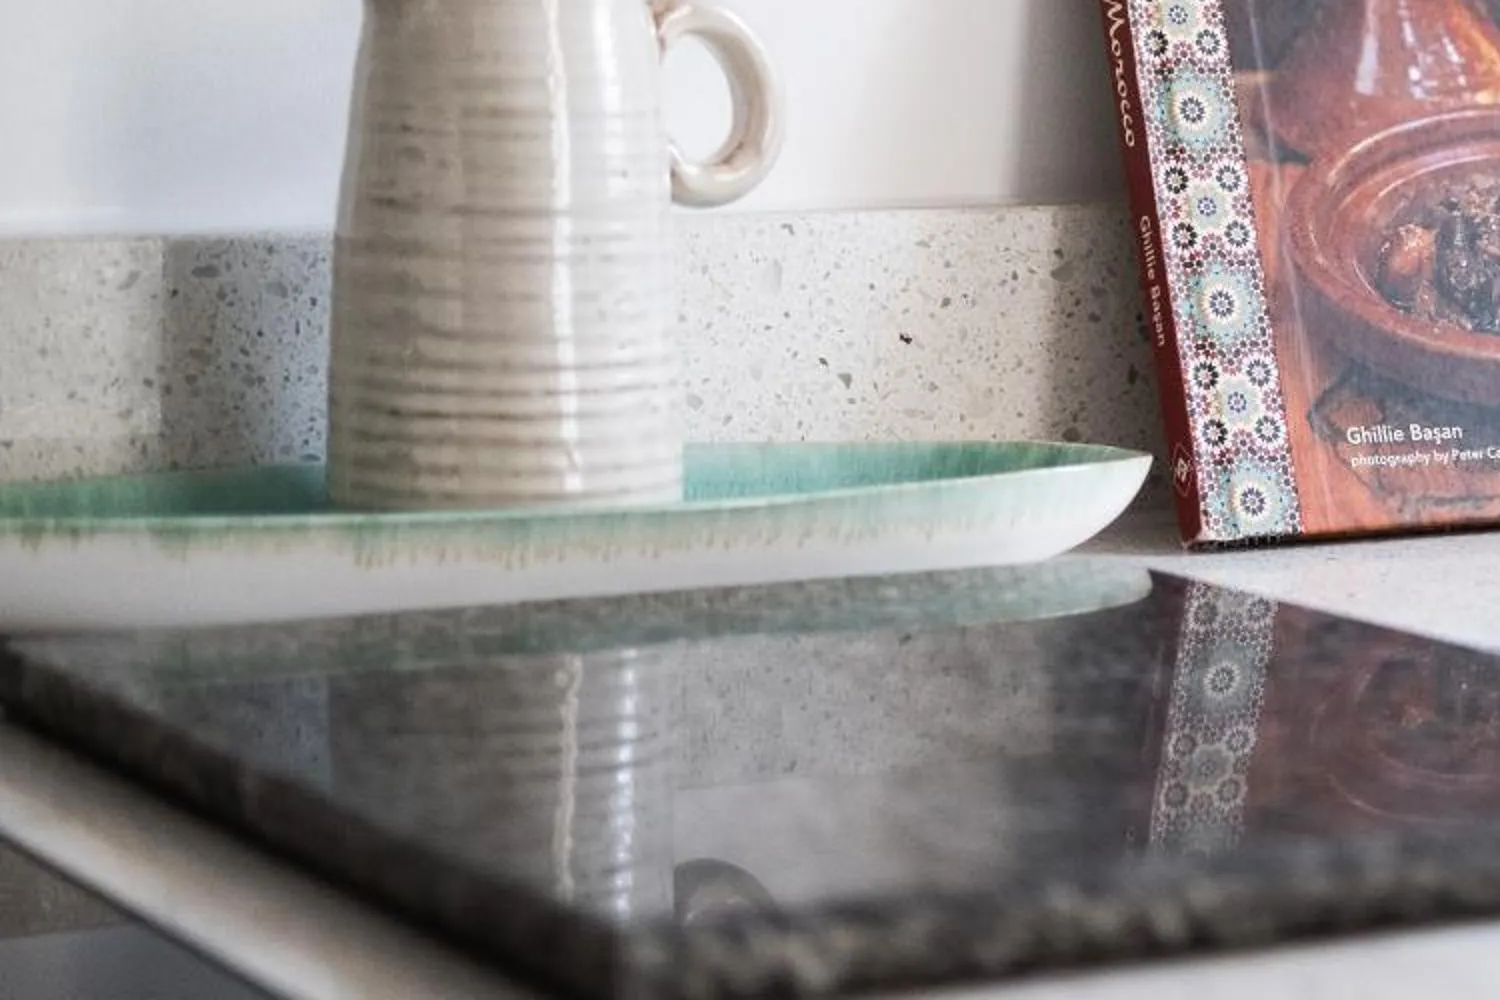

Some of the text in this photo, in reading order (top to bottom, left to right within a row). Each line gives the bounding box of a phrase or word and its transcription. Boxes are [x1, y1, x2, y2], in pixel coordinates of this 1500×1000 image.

[1346, 424, 1405, 445] Ghillie
[1350, 451, 1431, 468] photography
[1433, 451, 1449, 465] by
[1451, 449, 1483, 462] Peter
